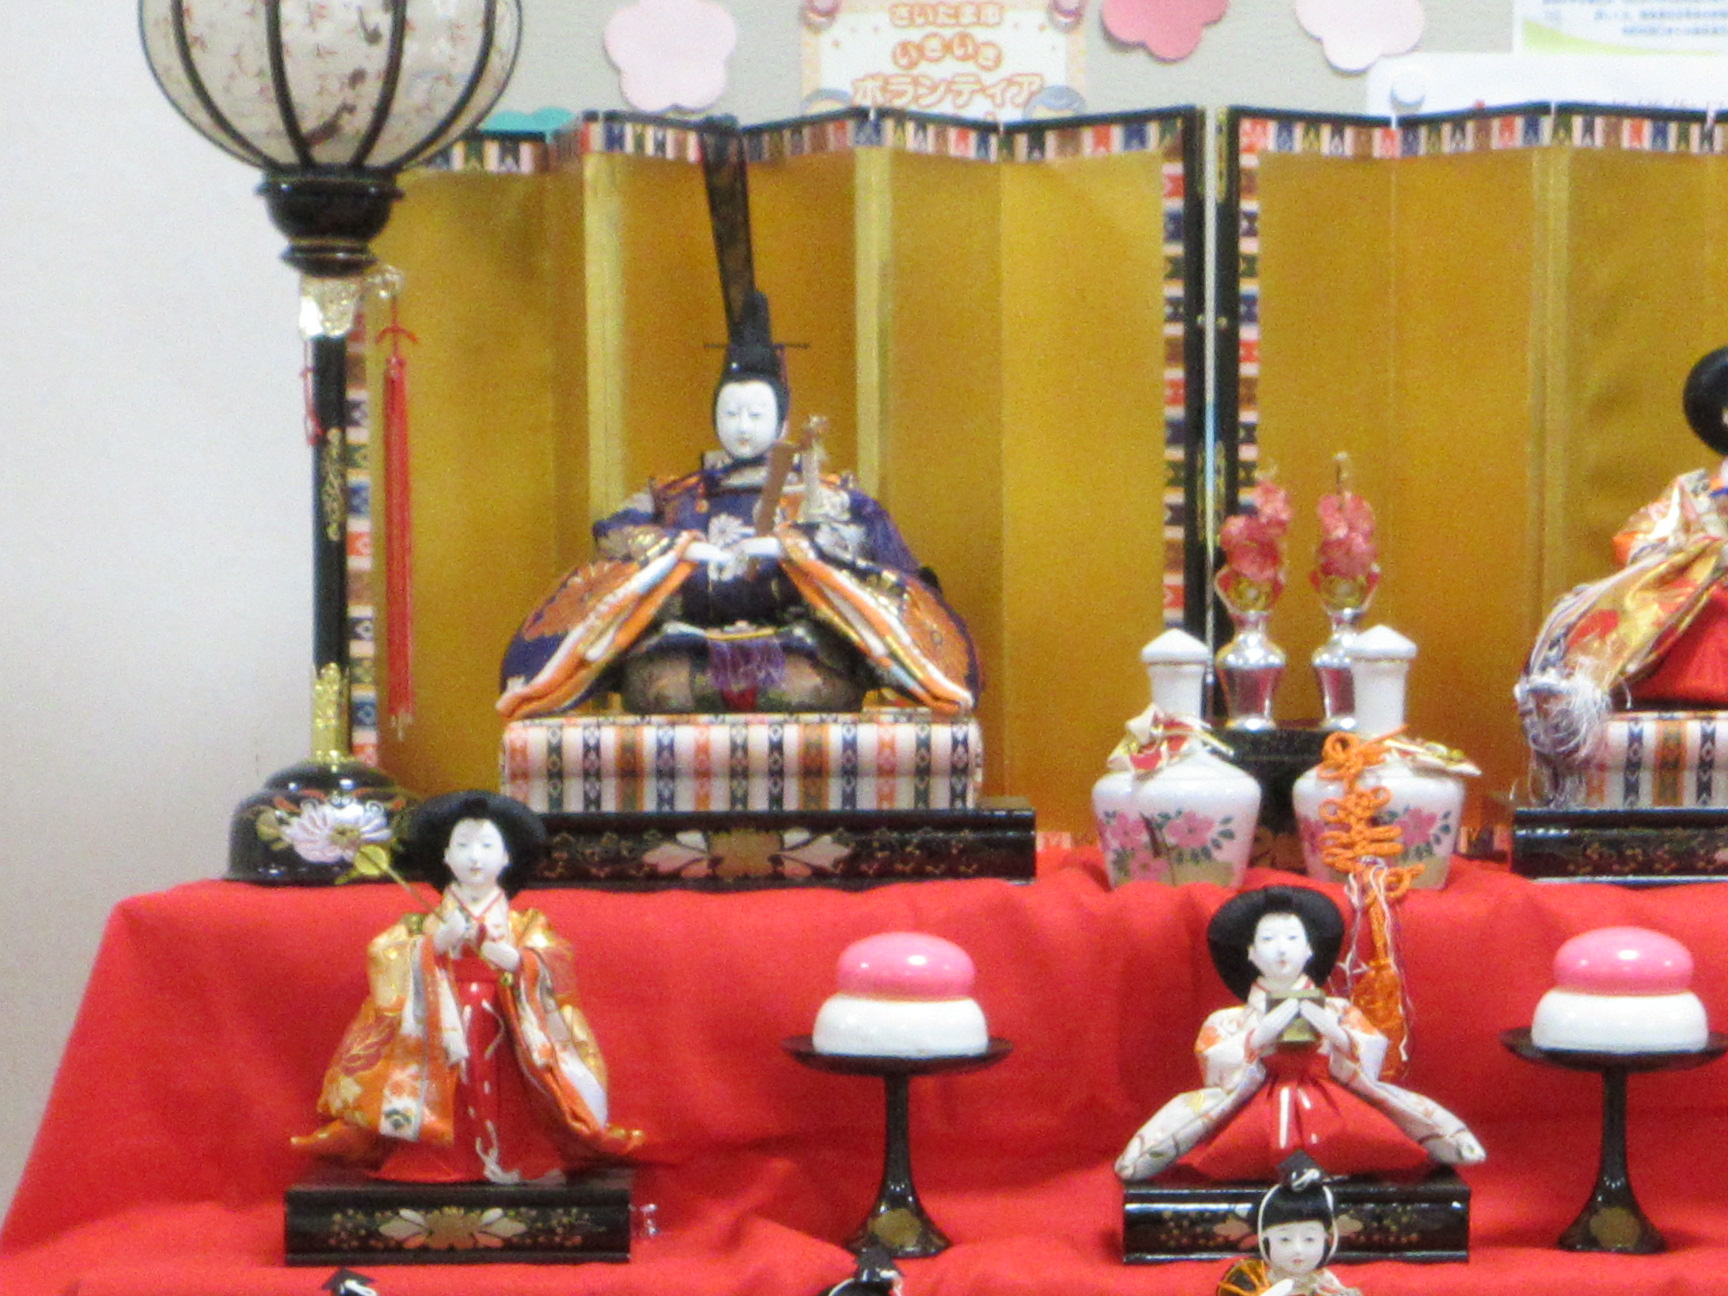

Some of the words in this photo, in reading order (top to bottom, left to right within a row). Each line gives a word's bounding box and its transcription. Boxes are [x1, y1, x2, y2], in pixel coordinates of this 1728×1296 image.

[851, 73, 1044, 109] ボランティア
